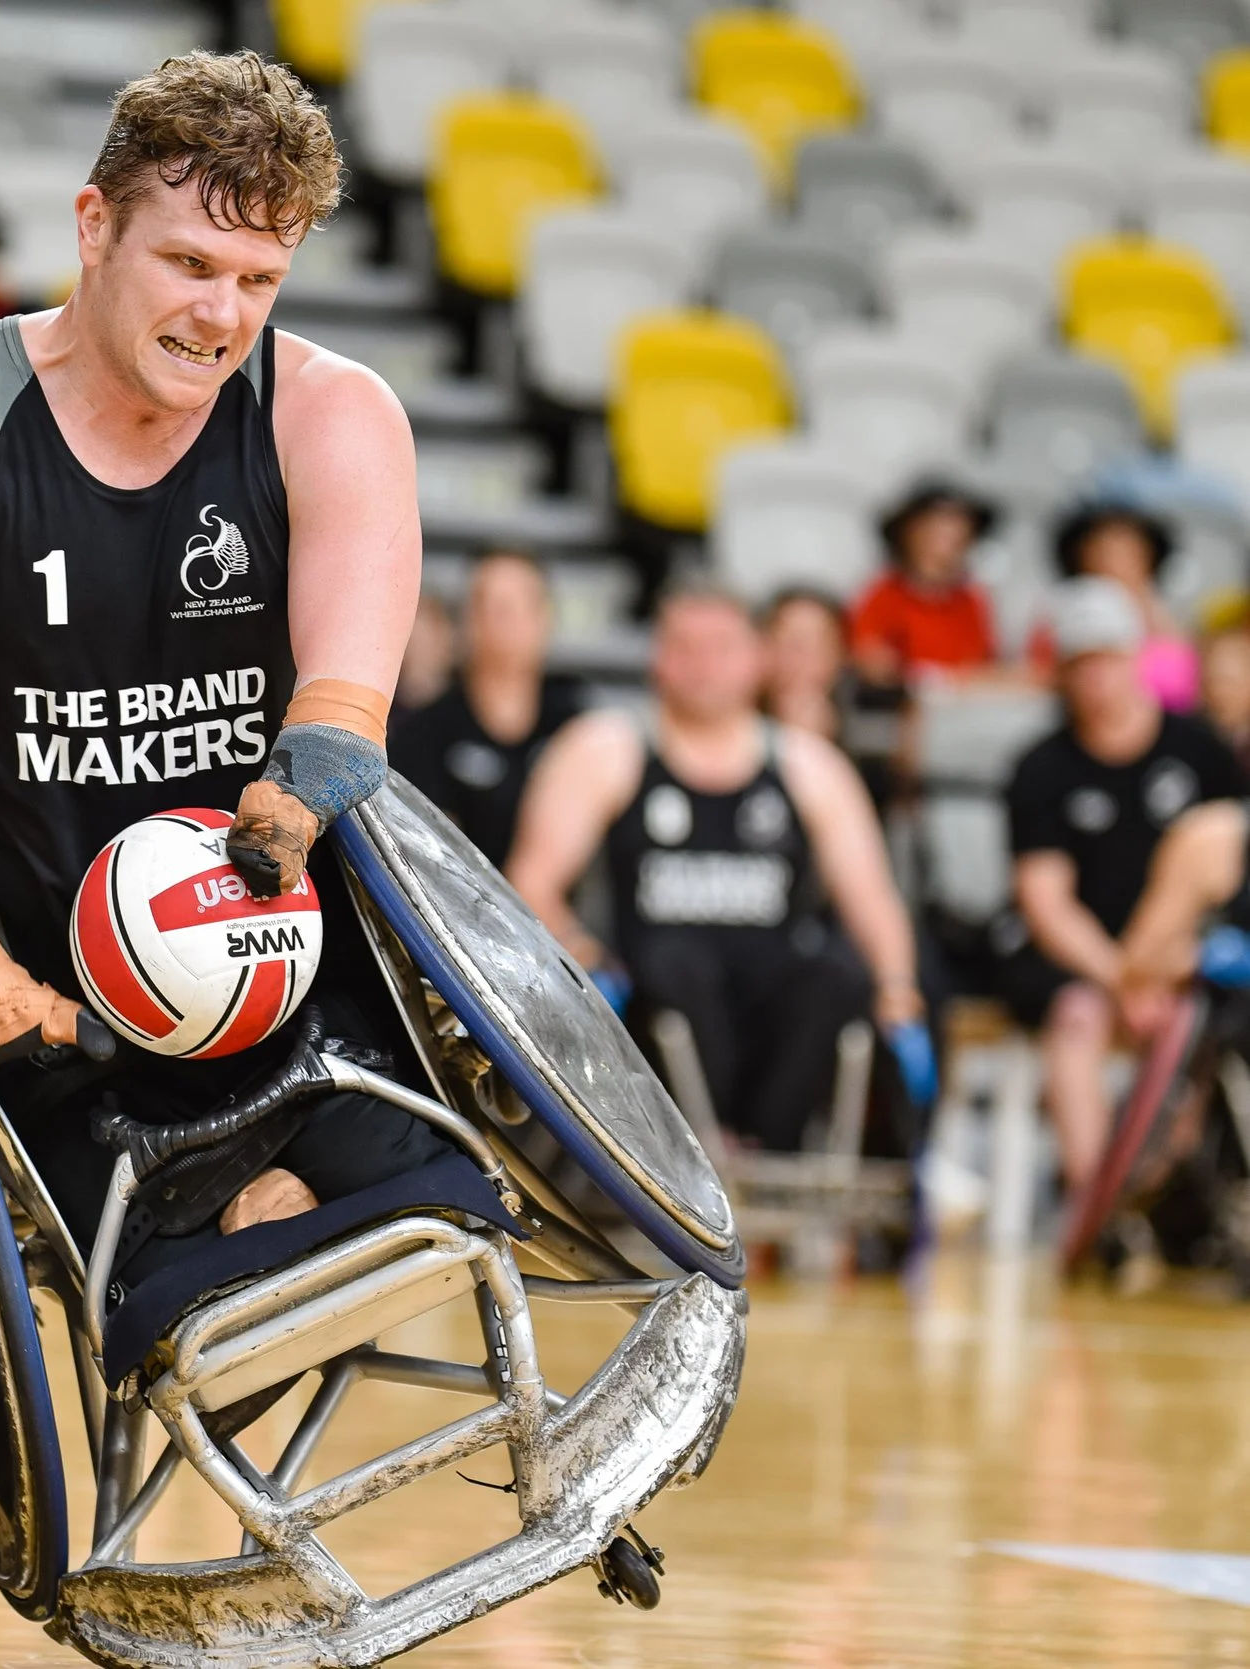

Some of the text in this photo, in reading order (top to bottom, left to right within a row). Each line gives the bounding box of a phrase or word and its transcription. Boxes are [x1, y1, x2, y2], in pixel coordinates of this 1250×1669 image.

[32, 549, 69, 625] 1
[170, 602, 265, 619] WHEELCHAIR RUGBY
[184, 595, 252, 610] NEW ZEALAND
[13, 666, 266, 728] THE BRAND
[15, 710, 267, 785] MAKERS
